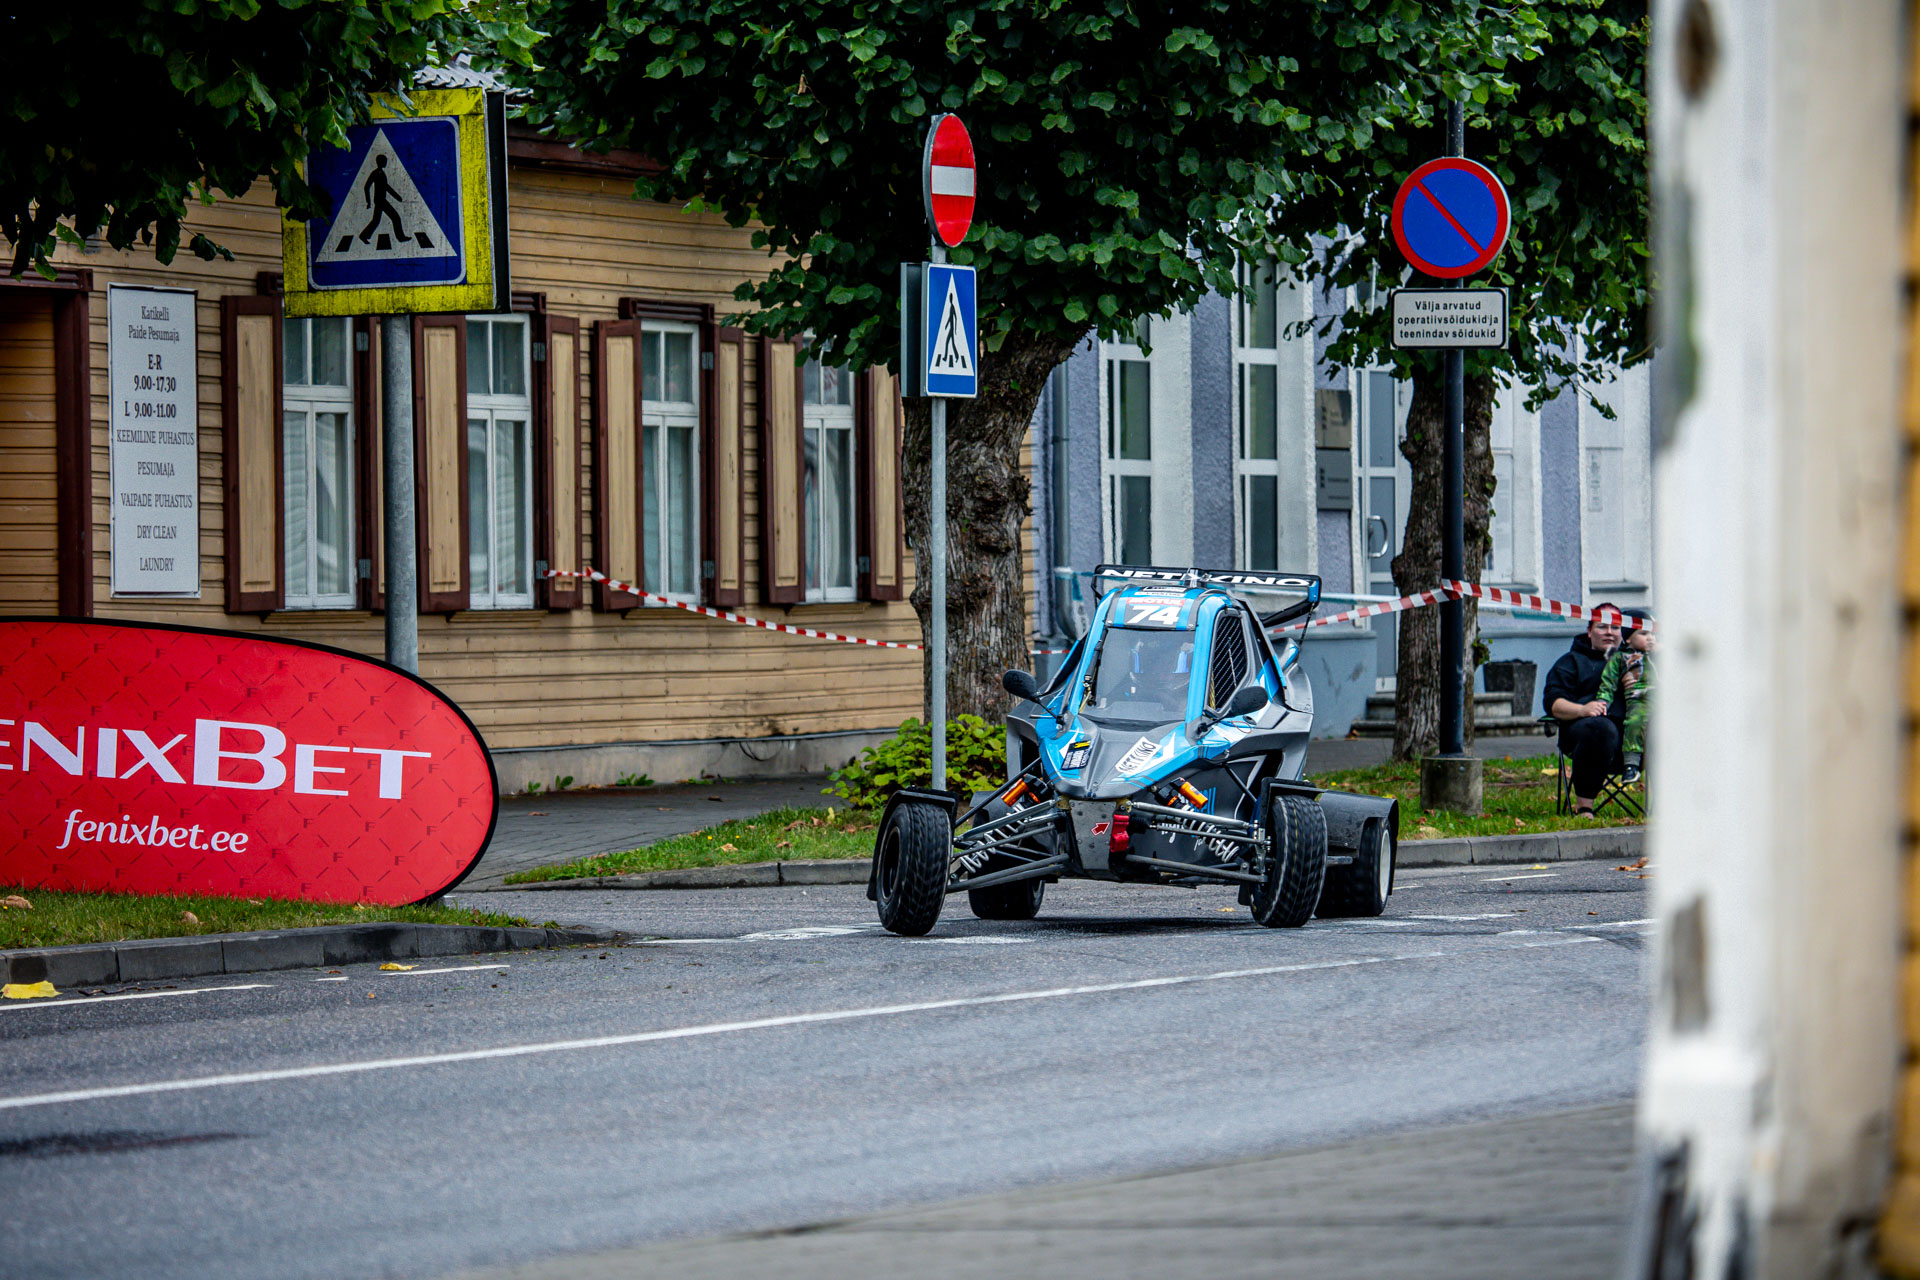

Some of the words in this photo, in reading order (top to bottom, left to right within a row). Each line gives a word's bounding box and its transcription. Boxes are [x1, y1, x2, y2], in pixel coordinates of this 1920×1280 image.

[1415, 301, 1440, 312] Välja
[1443, 301, 1481, 310] arvatud
[1397, 315, 1487, 326] operatiivsõidukid
[1489, 316, 1499, 326] ja
[128, 324, 147, 339] Paide
[148, 326, 179, 344] Pesumaja
[1400, 330, 1450, 339] teenindav
[1452, 329, 1496, 338] sõidukid
[148, 354, 162, 370] E-R
[124, 401, 130, 416] L
[117, 429, 156, 444] KEEMILINE
[158, 431, 194, 445] PUHASTUS
[137, 461, 175, 478] PESUMAJA
[121, 493, 152, 507] VAIPADE
[154, 494, 193, 508] PUHASTUS
[137, 525, 152, 538] DRY
[153, 526, 176, 539] CLEAN
[140, 558, 174, 571] LAUNDRY
[1127, 605, 1182, 625] 74
[56, 809, 249, 854] fenixbet.ee
